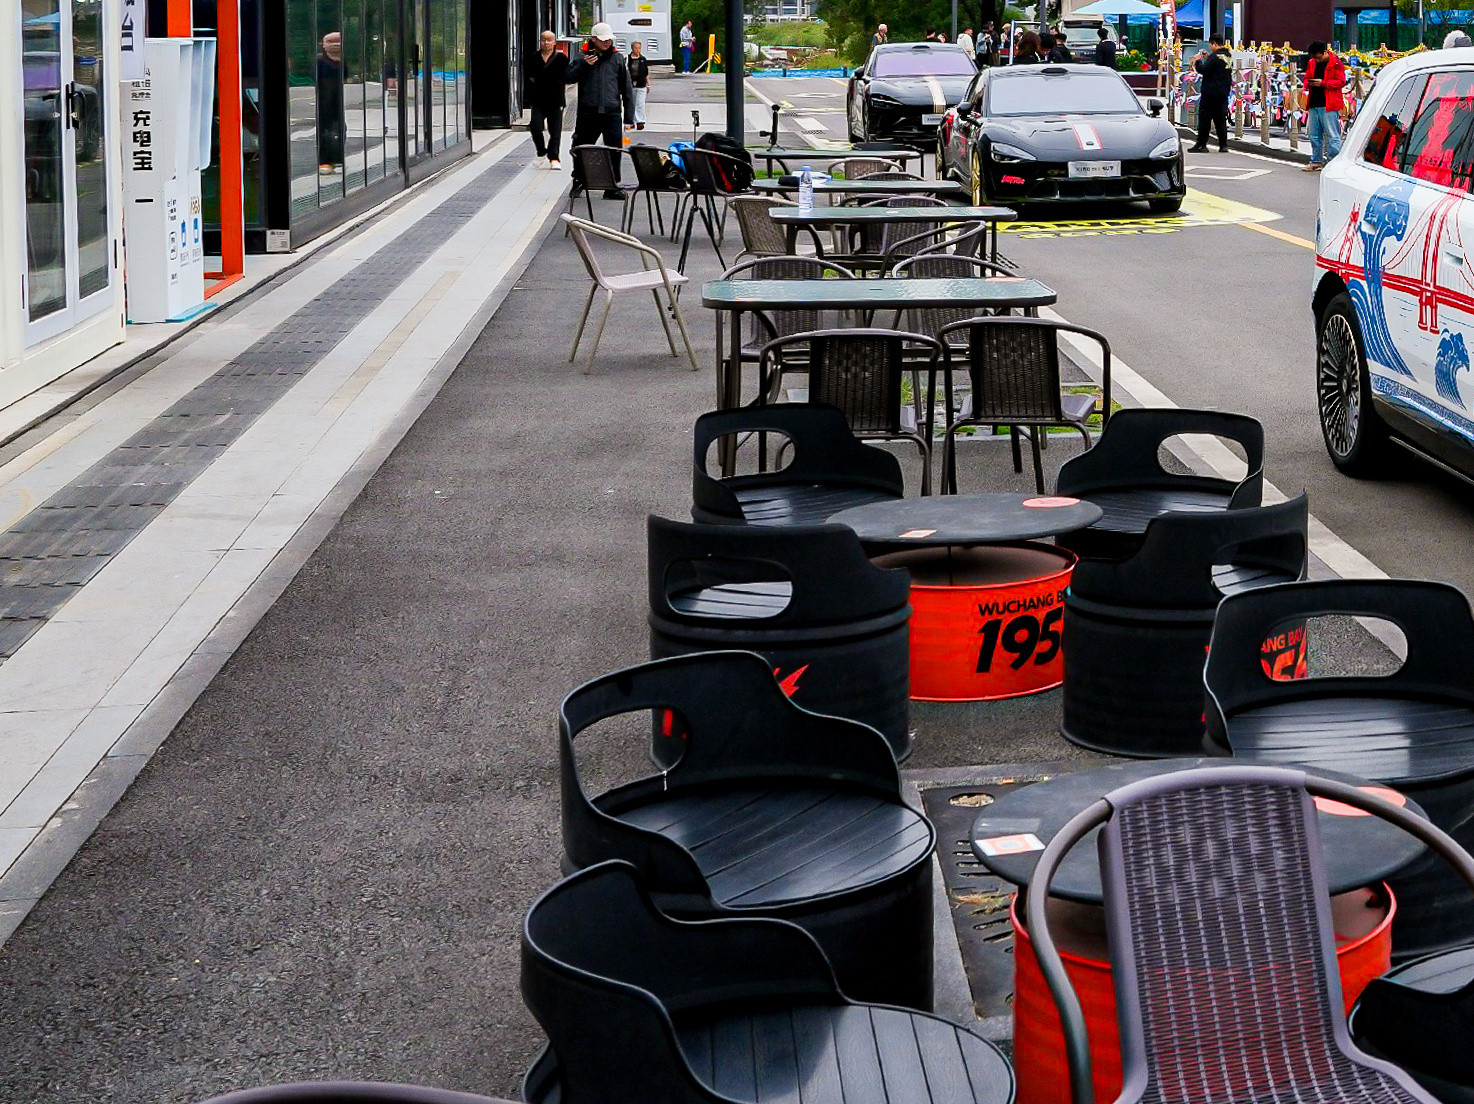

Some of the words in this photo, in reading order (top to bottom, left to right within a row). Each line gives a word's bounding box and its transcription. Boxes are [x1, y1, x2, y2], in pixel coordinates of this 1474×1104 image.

[132, 109, 153, 171] 充电宝
[978, 592, 1054, 616] WUCHANG
[976, 605, 1064, 673] 195
